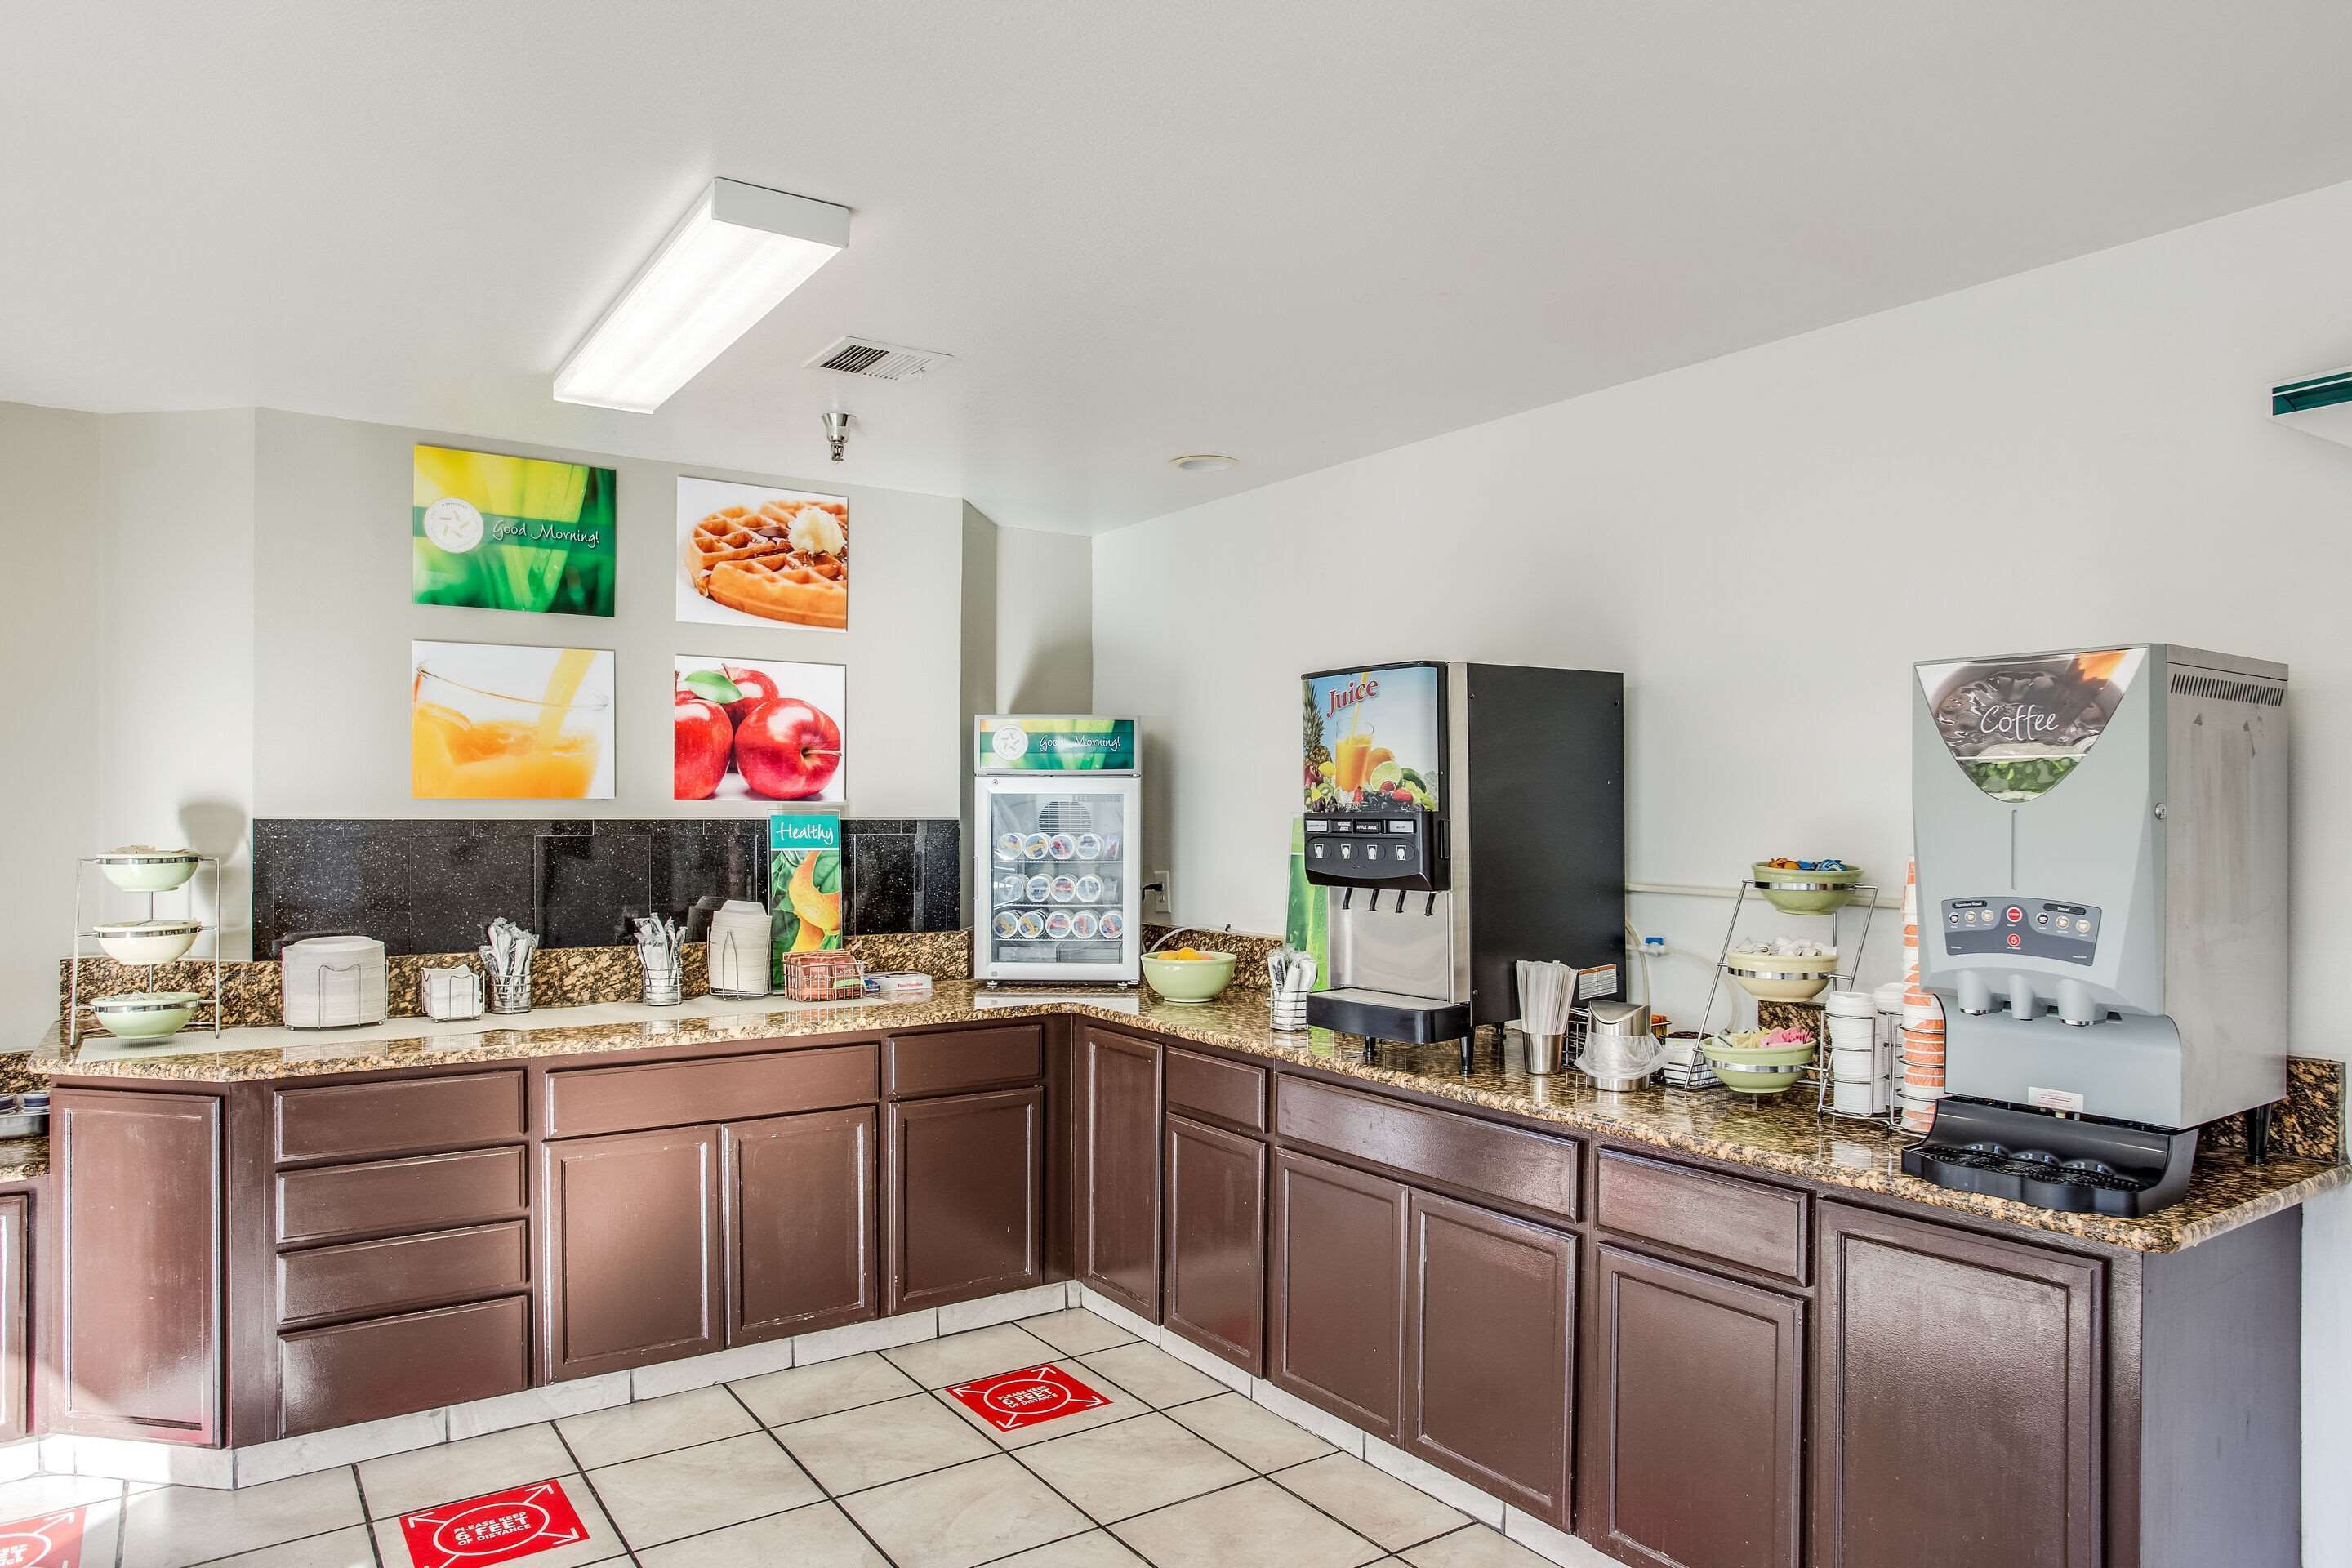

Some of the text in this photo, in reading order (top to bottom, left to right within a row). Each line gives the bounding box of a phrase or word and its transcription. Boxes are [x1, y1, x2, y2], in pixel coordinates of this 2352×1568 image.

[492, 519, 599, 549] Good Morning!
[1326, 680, 1379, 718] Juice
[1980, 704, 2058, 741] Coffee
[1074, 735, 1120, 751] Morning!
[776, 822, 833, 845] Healthy
[1014, 1388, 1052, 1402] FEET
[453, 1512, 527, 1534] PLEASE KEEP
[455, 1516, 528, 1541] 6 FEET
[457, 1523, 532, 1546] OF DISTANCE
